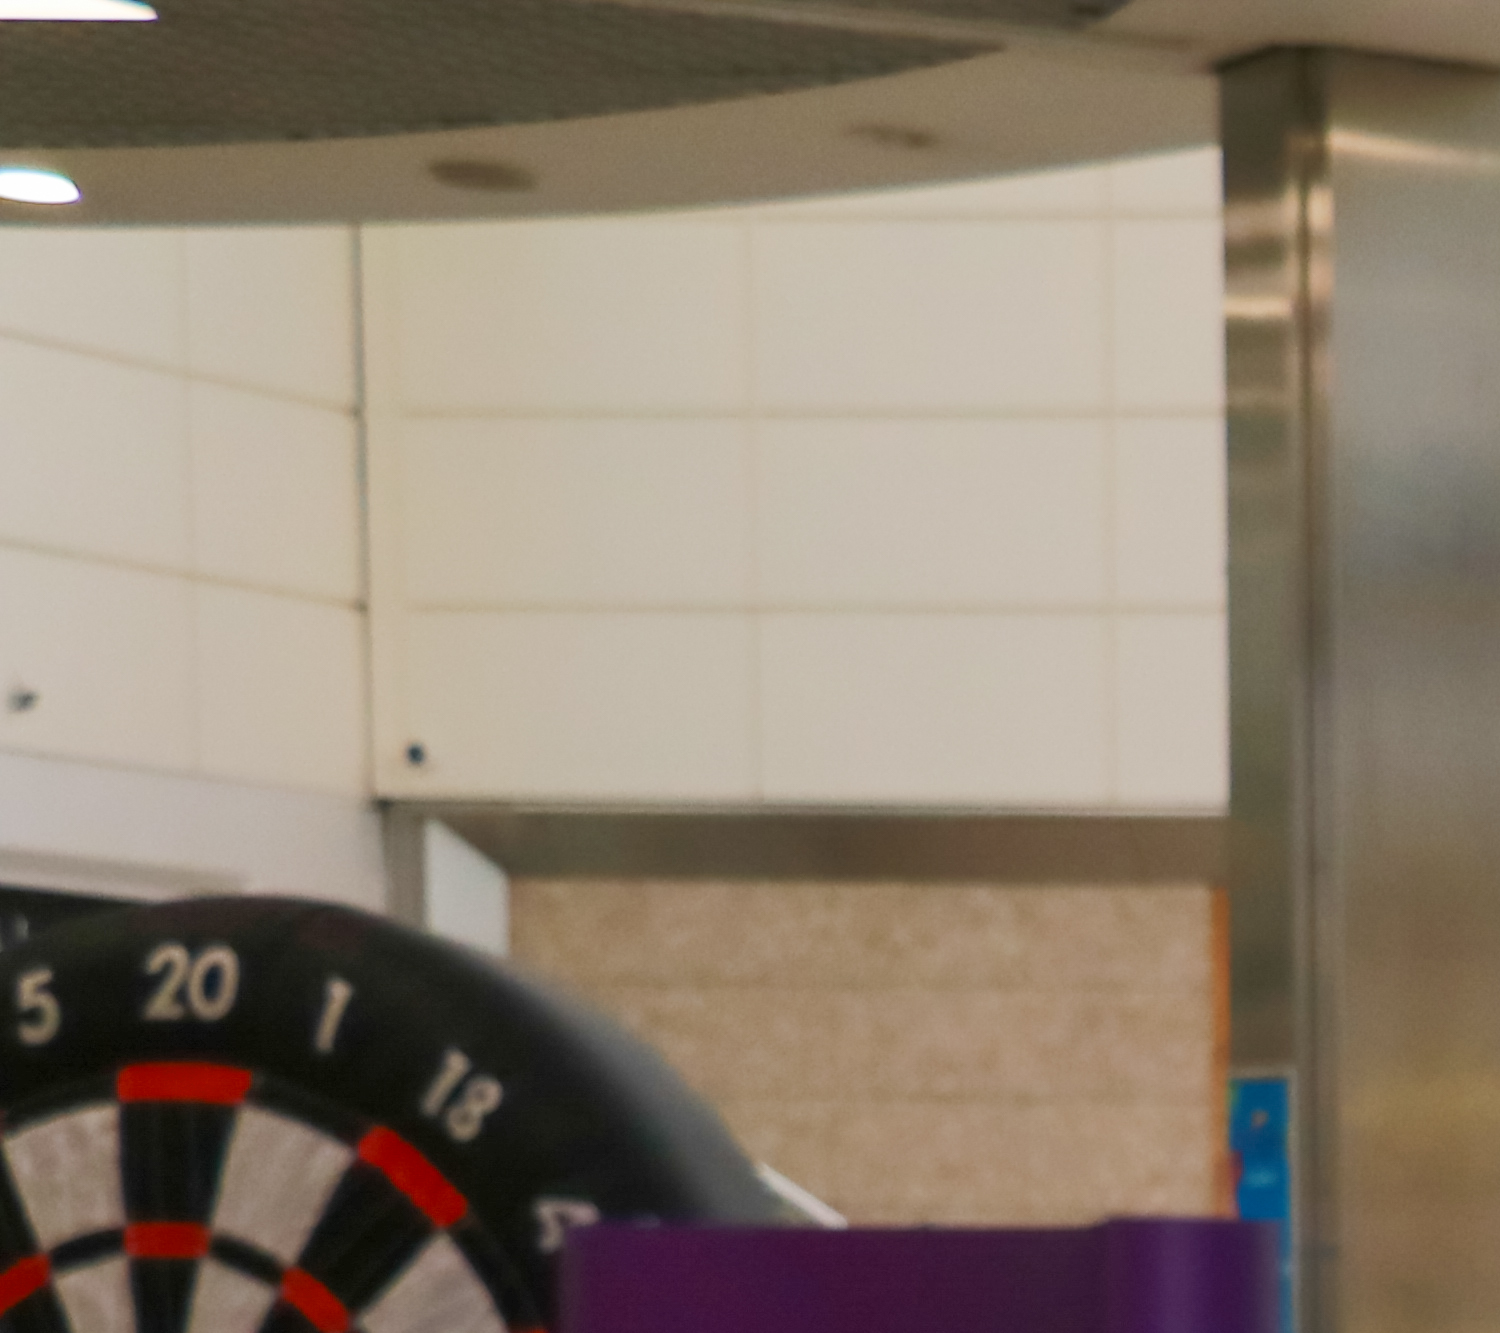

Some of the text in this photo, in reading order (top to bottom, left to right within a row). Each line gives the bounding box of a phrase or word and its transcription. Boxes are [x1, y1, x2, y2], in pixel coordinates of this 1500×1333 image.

[14, 968, 62, 1046] 5
[140, 942, 240, 1022] 20
[312, 975, 355, 1056] 1
[416, 1046, 506, 1144] 18
